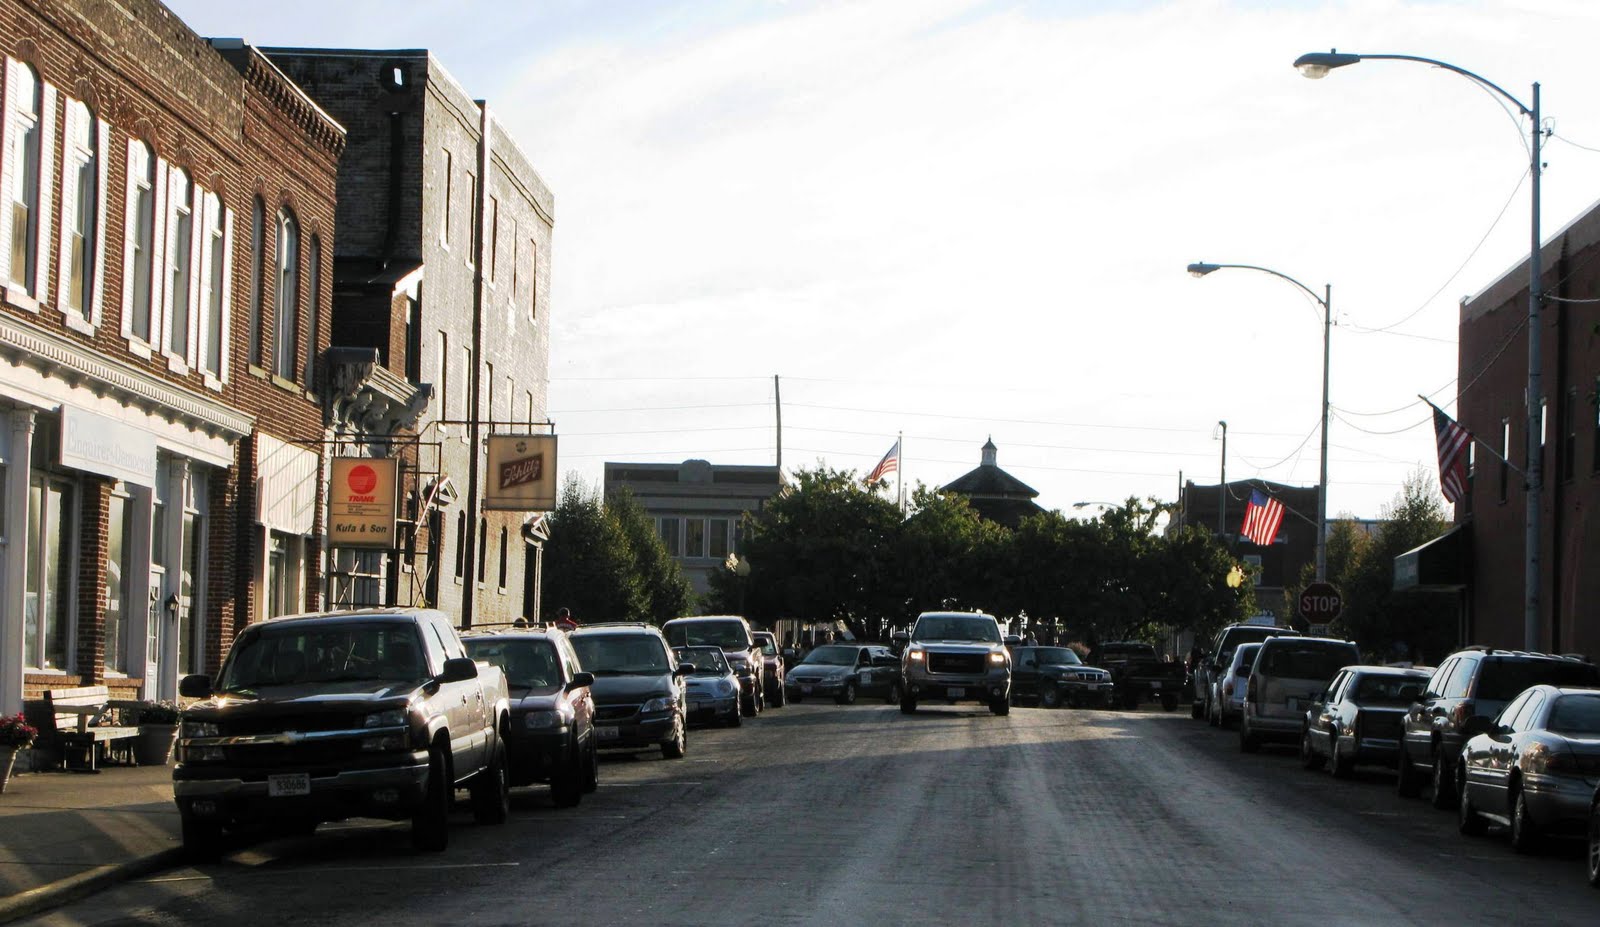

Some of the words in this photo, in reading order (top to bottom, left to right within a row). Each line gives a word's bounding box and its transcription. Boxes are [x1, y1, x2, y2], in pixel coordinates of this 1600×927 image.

[503, 459, 540, 487] Schlitz
[336, 523, 357, 533] Kufa
[360, 524, 366, 533] &
[370, 524, 387, 534] Son
[1303, 595, 1339, 612] STOP
